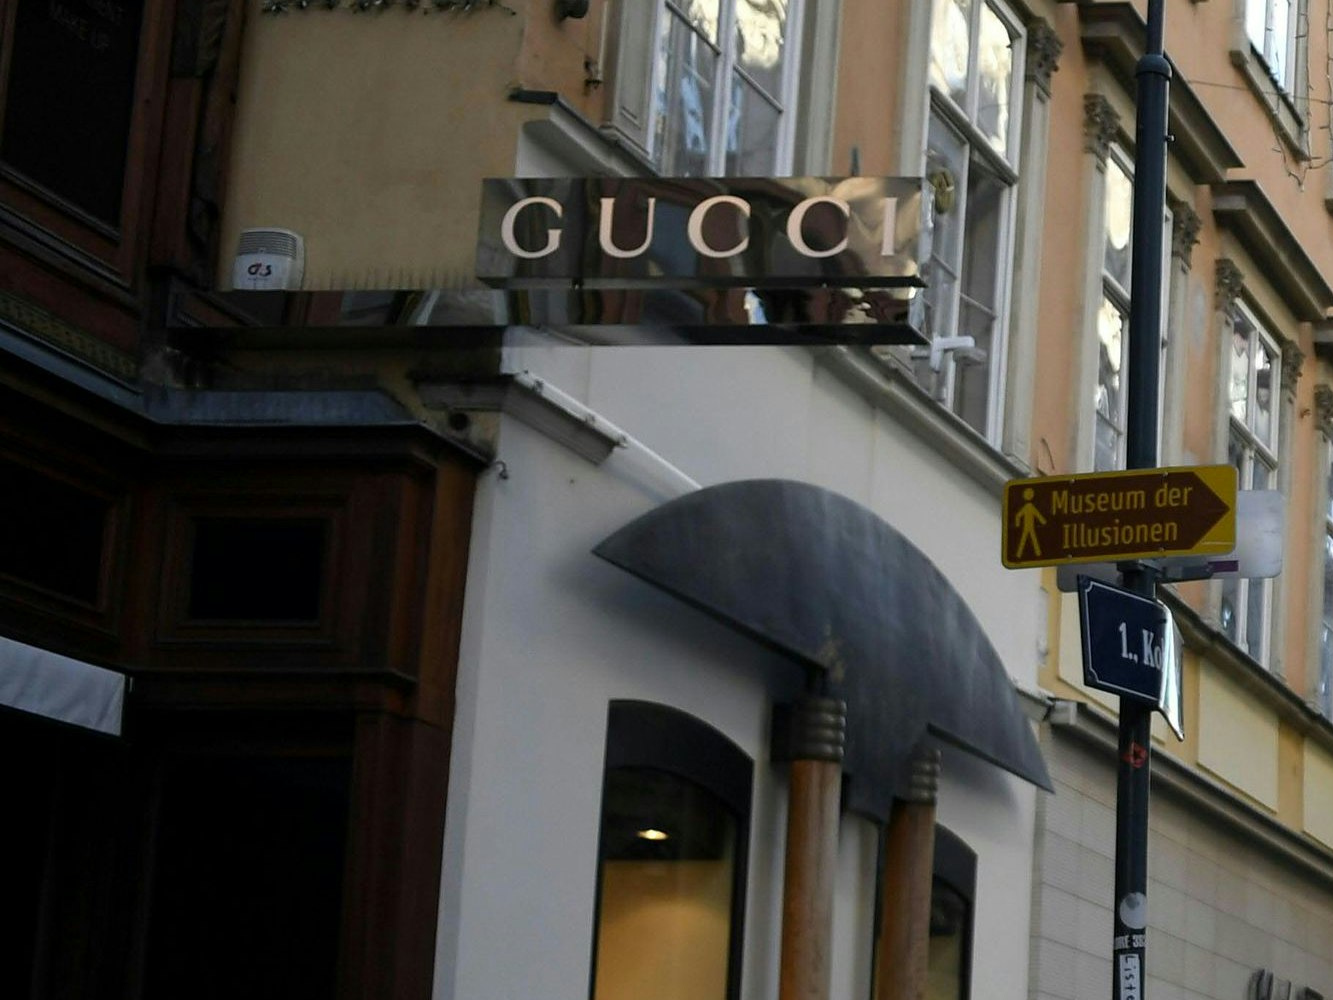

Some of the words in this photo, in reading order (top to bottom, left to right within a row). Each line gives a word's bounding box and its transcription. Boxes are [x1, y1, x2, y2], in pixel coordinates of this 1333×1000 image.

[500, 194, 897, 258] GUCCI
[1052, 489, 1147, 516] Museum
[1155, 482, 1192, 508] der
[1063, 520, 1177, 550] Illusionen
[1143, 629, 1164, 670] Ko
